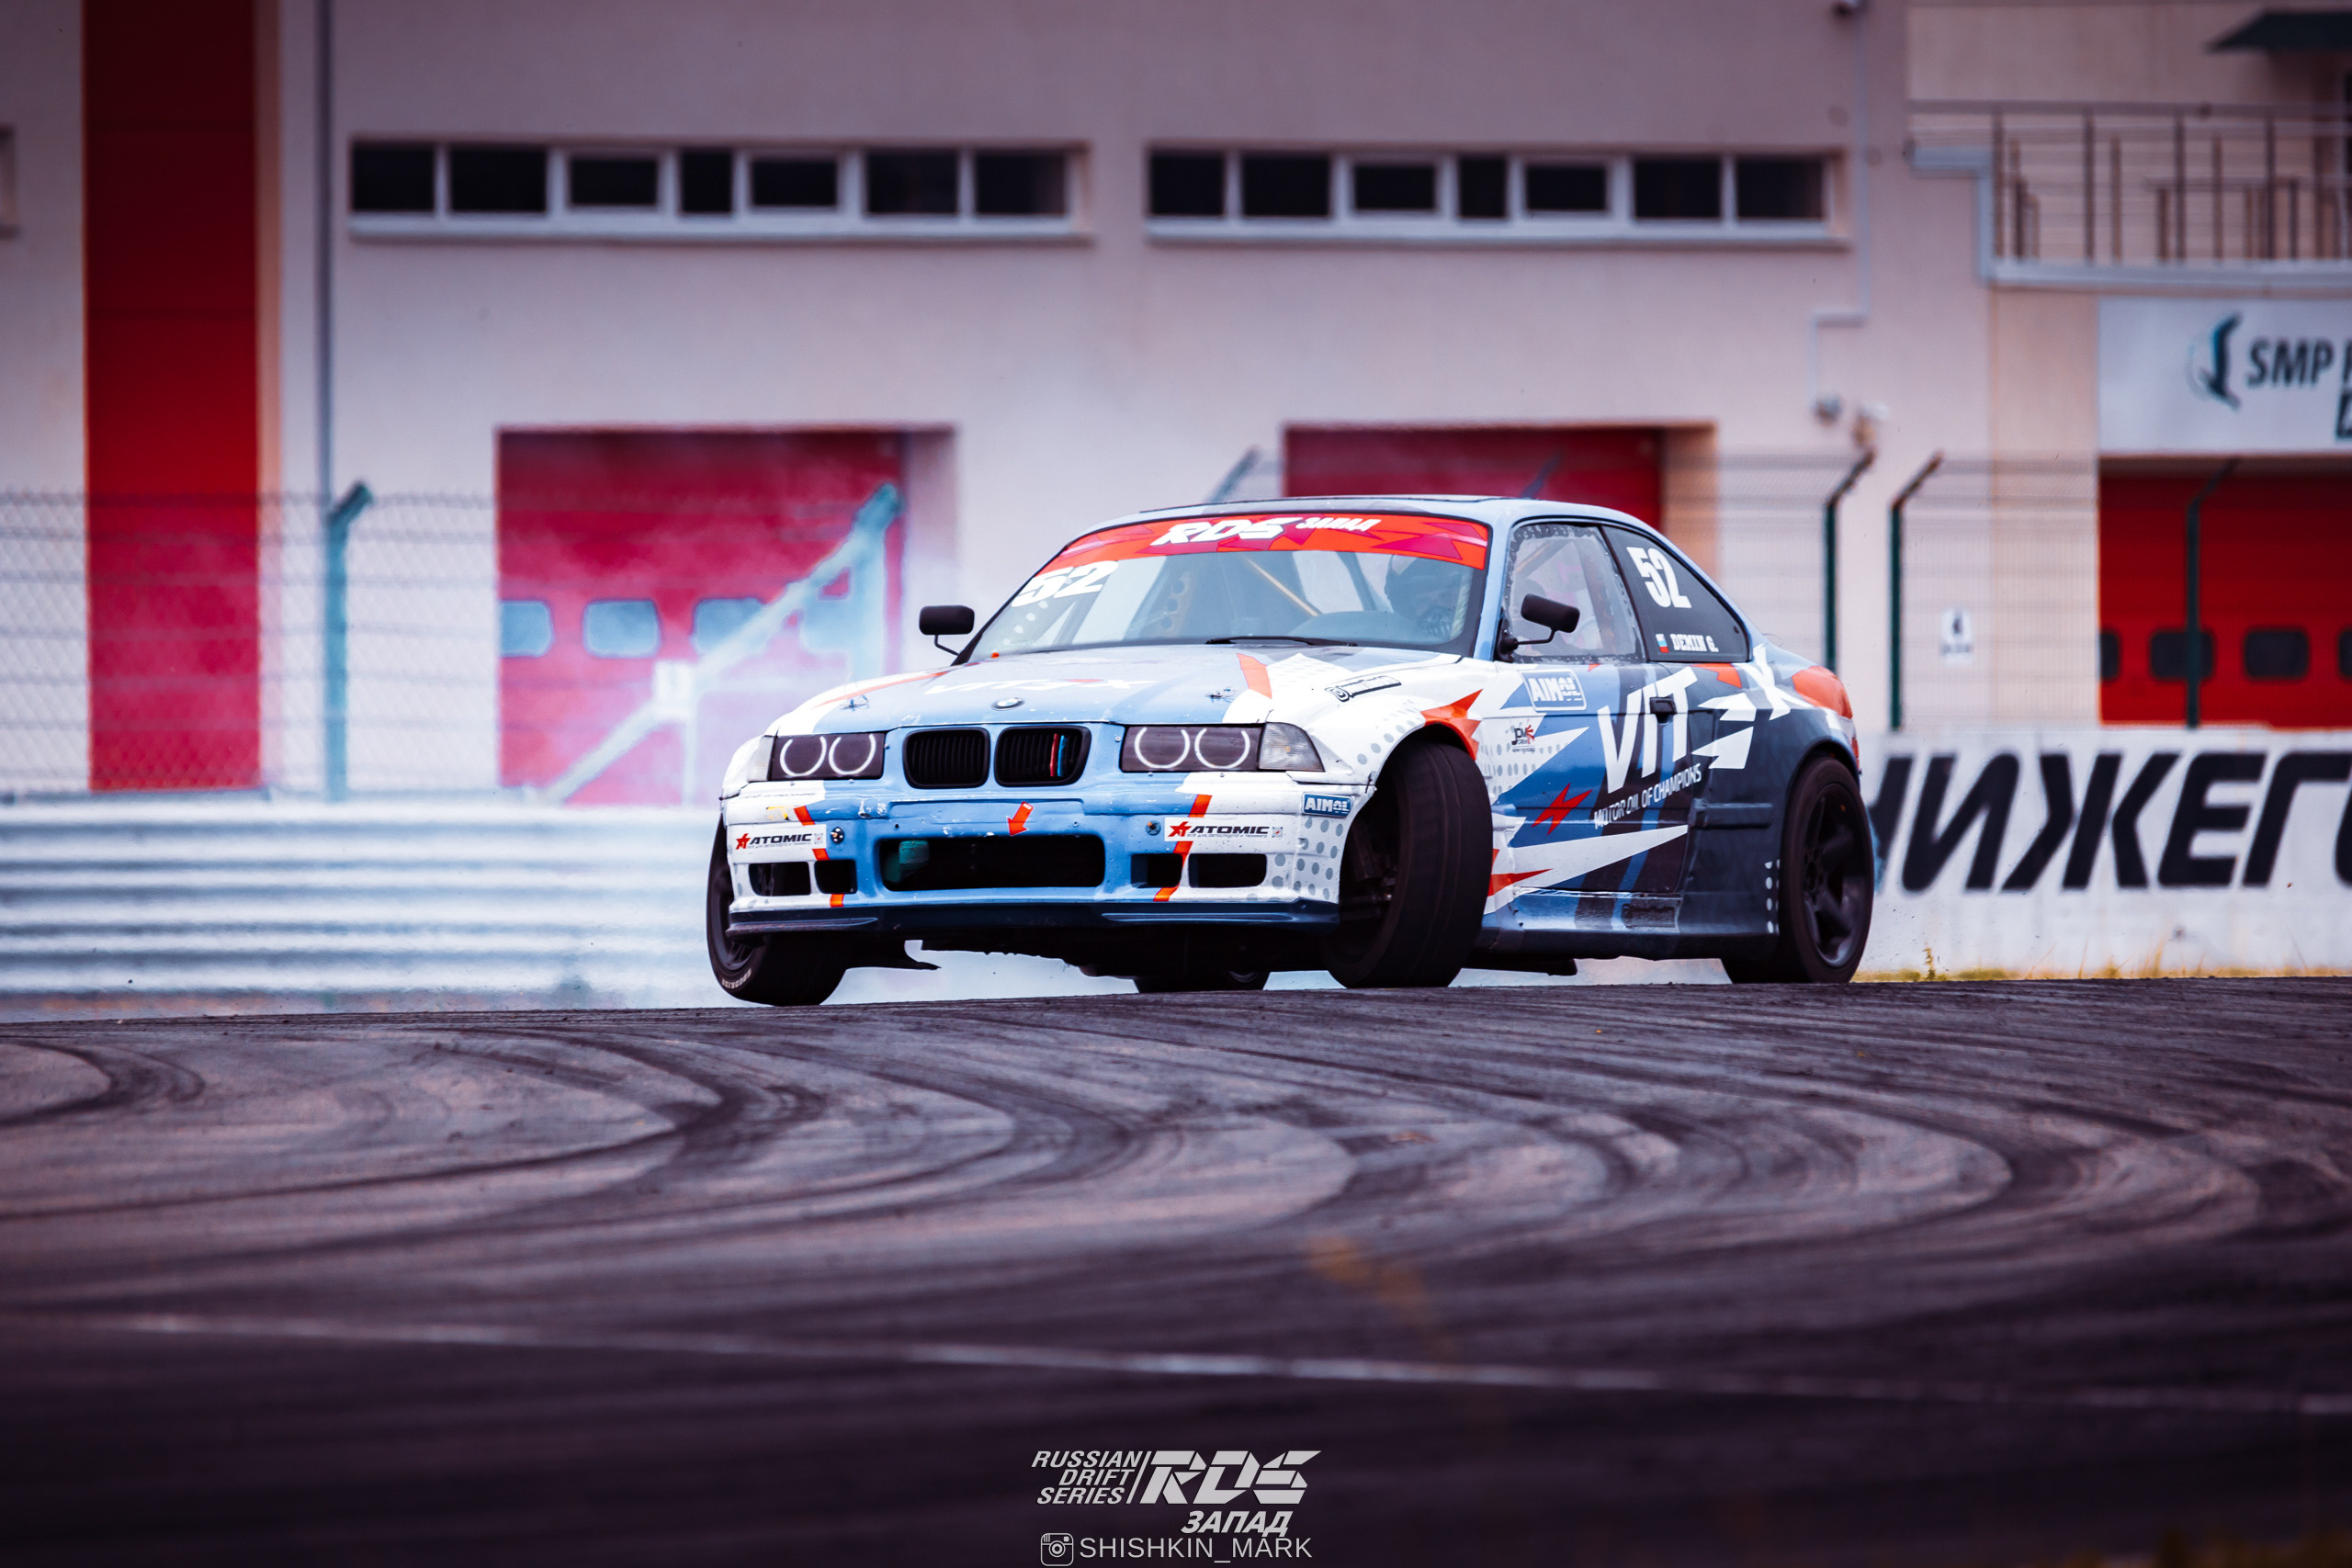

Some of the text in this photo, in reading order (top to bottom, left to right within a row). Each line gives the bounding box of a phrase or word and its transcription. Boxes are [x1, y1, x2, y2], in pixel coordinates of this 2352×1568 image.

[2245, 337, 2335, 387] SMP
[1149, 517, 1303, 546] RDS
[1012, 560, 1118, 607] 52
[1626, 546, 1691, 608] 52
[1669, 633, 1707, 651] DEMIN
[1594, 762, 1702, 829] MOTOR OIL OF CHAMPIONS
[749, 833, 812, 845] ATOMIC
[1189, 826, 1271, 835] ATOMIC
